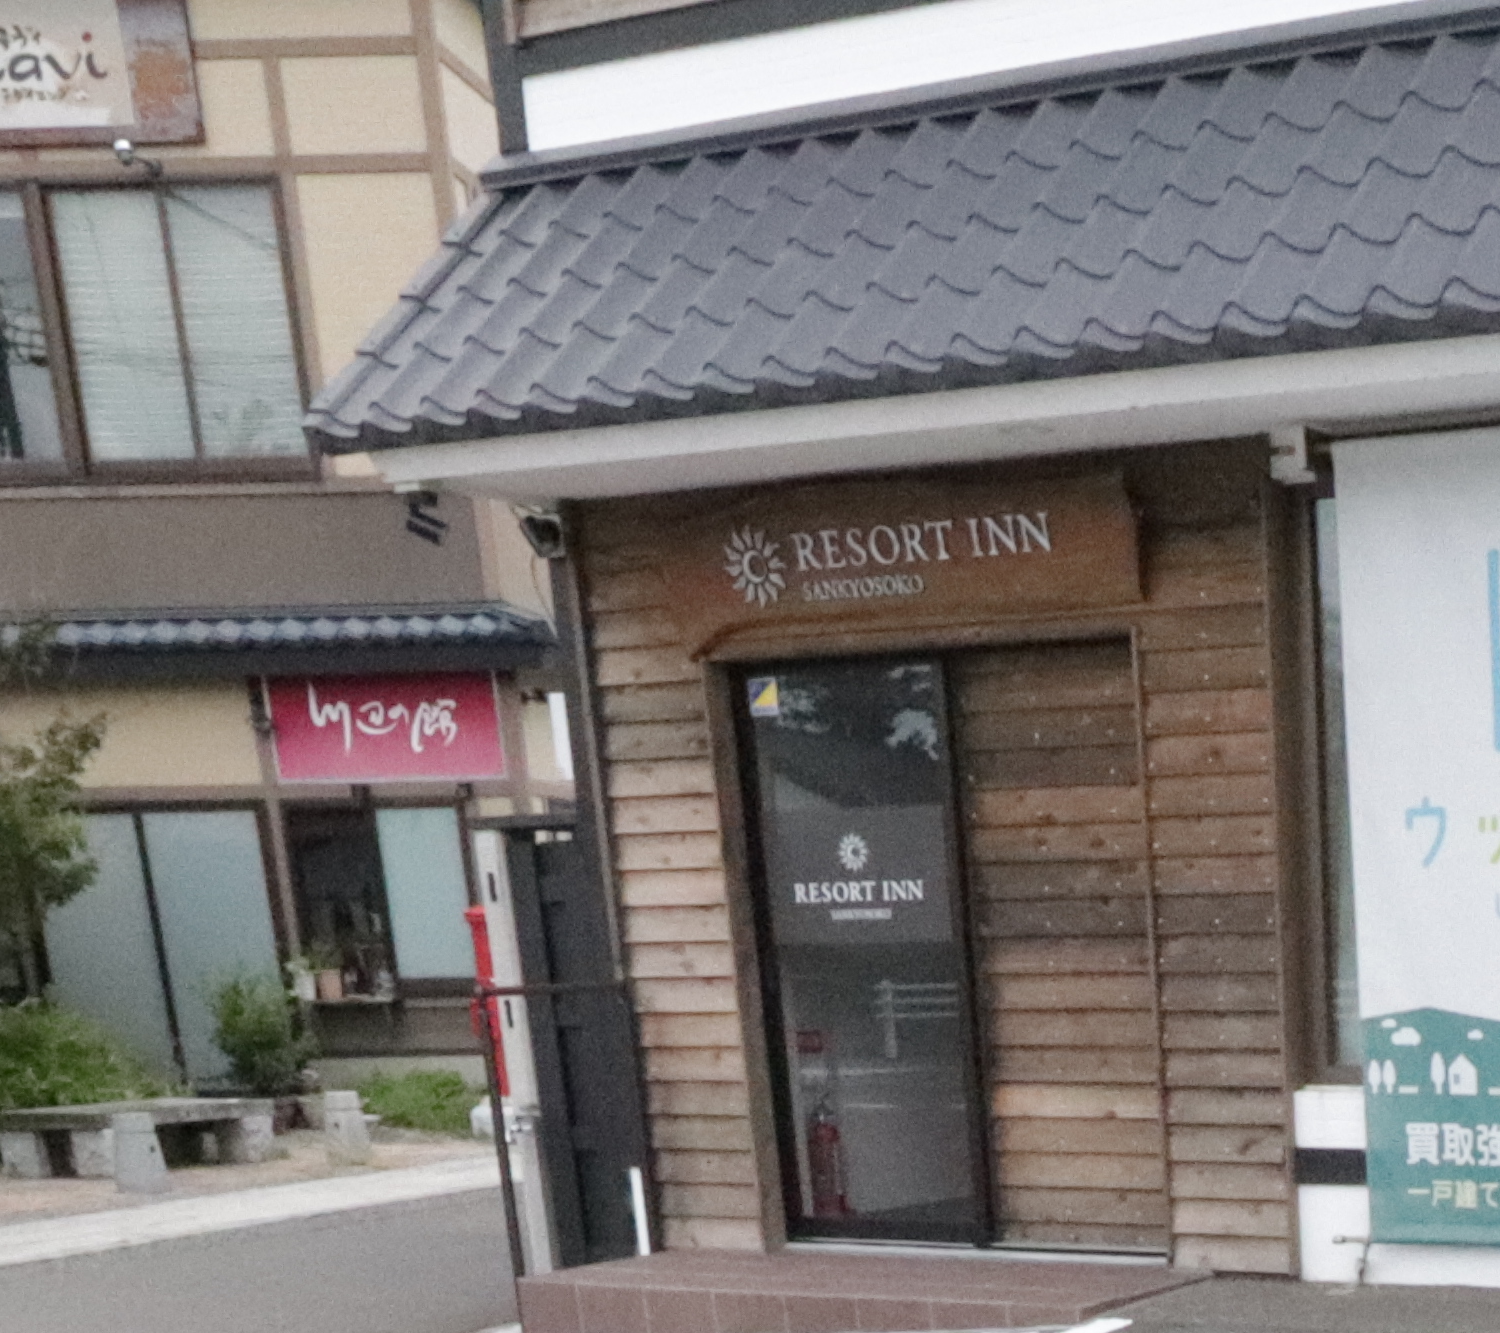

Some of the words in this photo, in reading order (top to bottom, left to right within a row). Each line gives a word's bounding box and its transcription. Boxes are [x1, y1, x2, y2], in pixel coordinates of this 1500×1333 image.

[790, 519, 952, 571] RESORT
[965, 511, 1051, 557] INN
[803, 574, 926, 602] SANKYOSOKO
[793, 880, 876, 903] RESORT
[882, 879, 924, 901] INN
